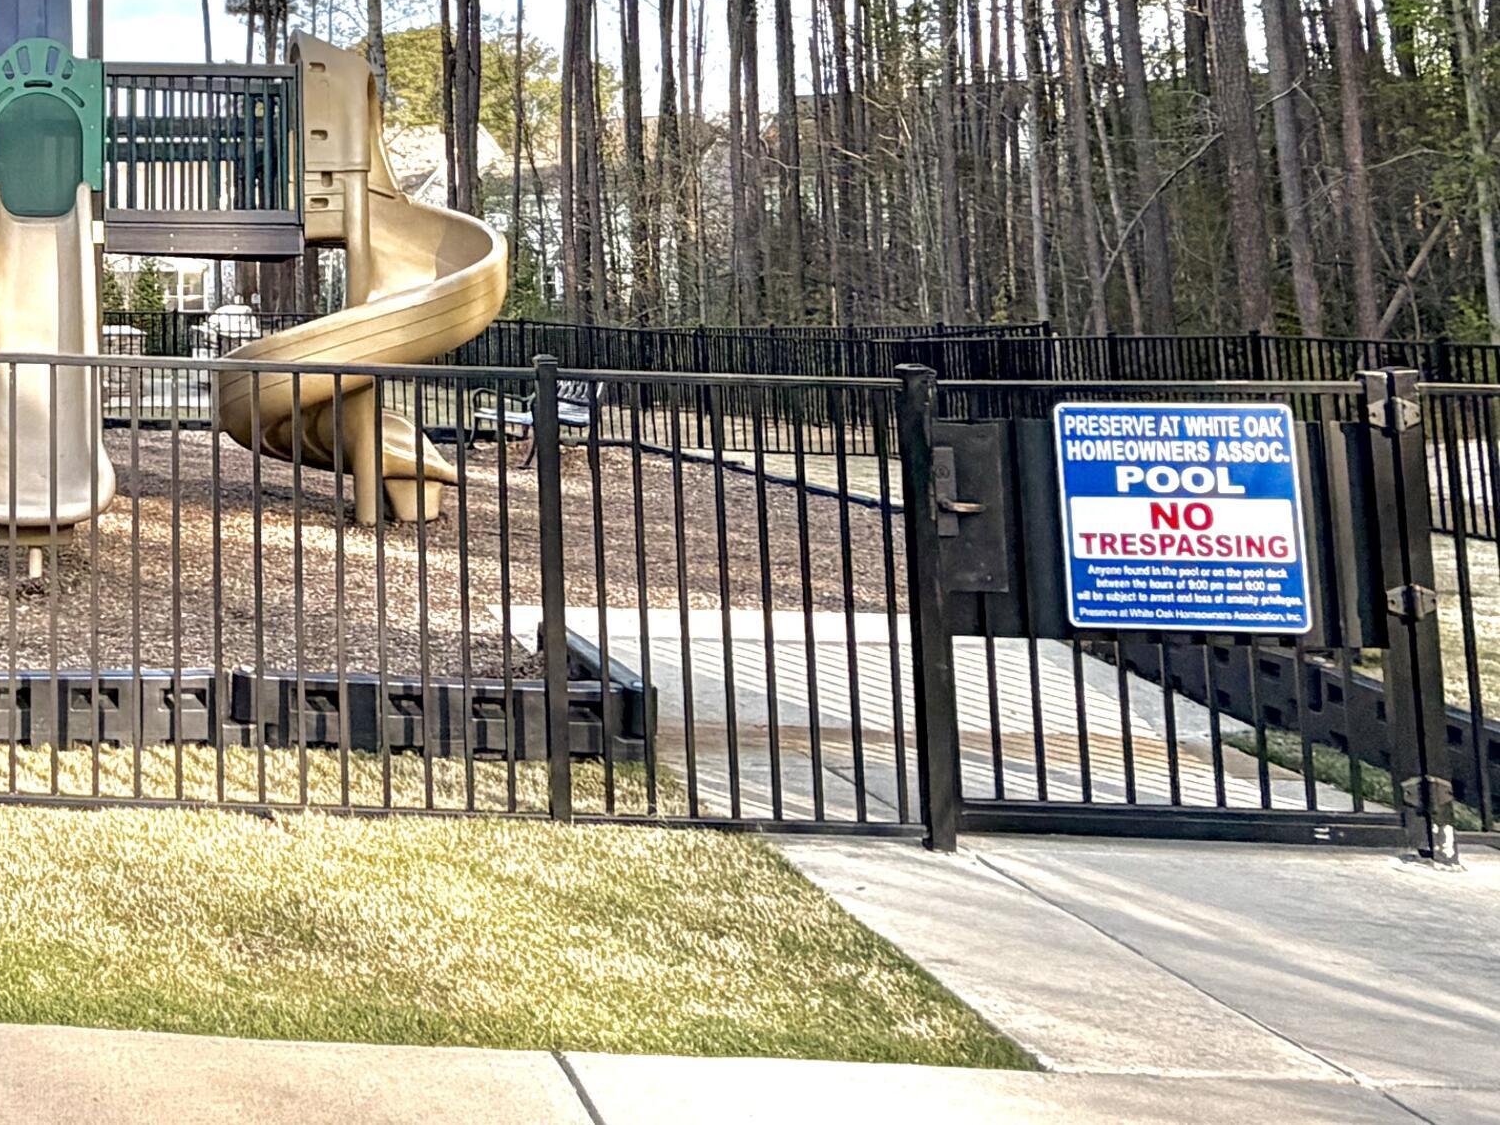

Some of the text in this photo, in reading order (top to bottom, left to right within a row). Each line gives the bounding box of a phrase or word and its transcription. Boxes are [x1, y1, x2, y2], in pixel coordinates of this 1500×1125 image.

[1064, 415, 1284, 438] PRESERVE AT WHITE OAK
[1066, 440, 1290, 463] HOMEOWNERS ASSOC.
[1115, 465, 1246, 494] POOL
[1149, 502, 1214, 531] NO
[1079, 532, 1289, 558] TRESPASSING
[1088, 564, 1288, 579] Anyone found in the pool or on the pool deck
[1096, 578, 1131, 588] between
[1132, 578, 1147, 589] the
[1149, 579, 1174, 589] hours
[1176, 579, 1186, 589] of
[1210, 581, 1224, 592] pm
[1226, 581, 1243, 591] and
[1267, 583, 1282, 592] am
[1077, 590, 1091, 600] will
[1092, 590, 1104, 601] be
[1106, 591, 1137, 603] subject
[1138, 592, 1148, 602] to
[1150, 593, 1175, 603] arrest
[1176, 593, 1193, 603] and
[1194, 593, 1213, 603] loss
[1214, 593, 1224, 604] of
[1226, 594, 1259, 607] amenity
[1079, 607, 1118, 617] Preserve
[1119, 609, 1128, 617] at
[1129, 609, 1155, 618] White
[1155, 609, 1174, 619] Oak
[1175, 609, 1233, 620] Homeowners
[1286, 613, 1303, 622] Inc.
